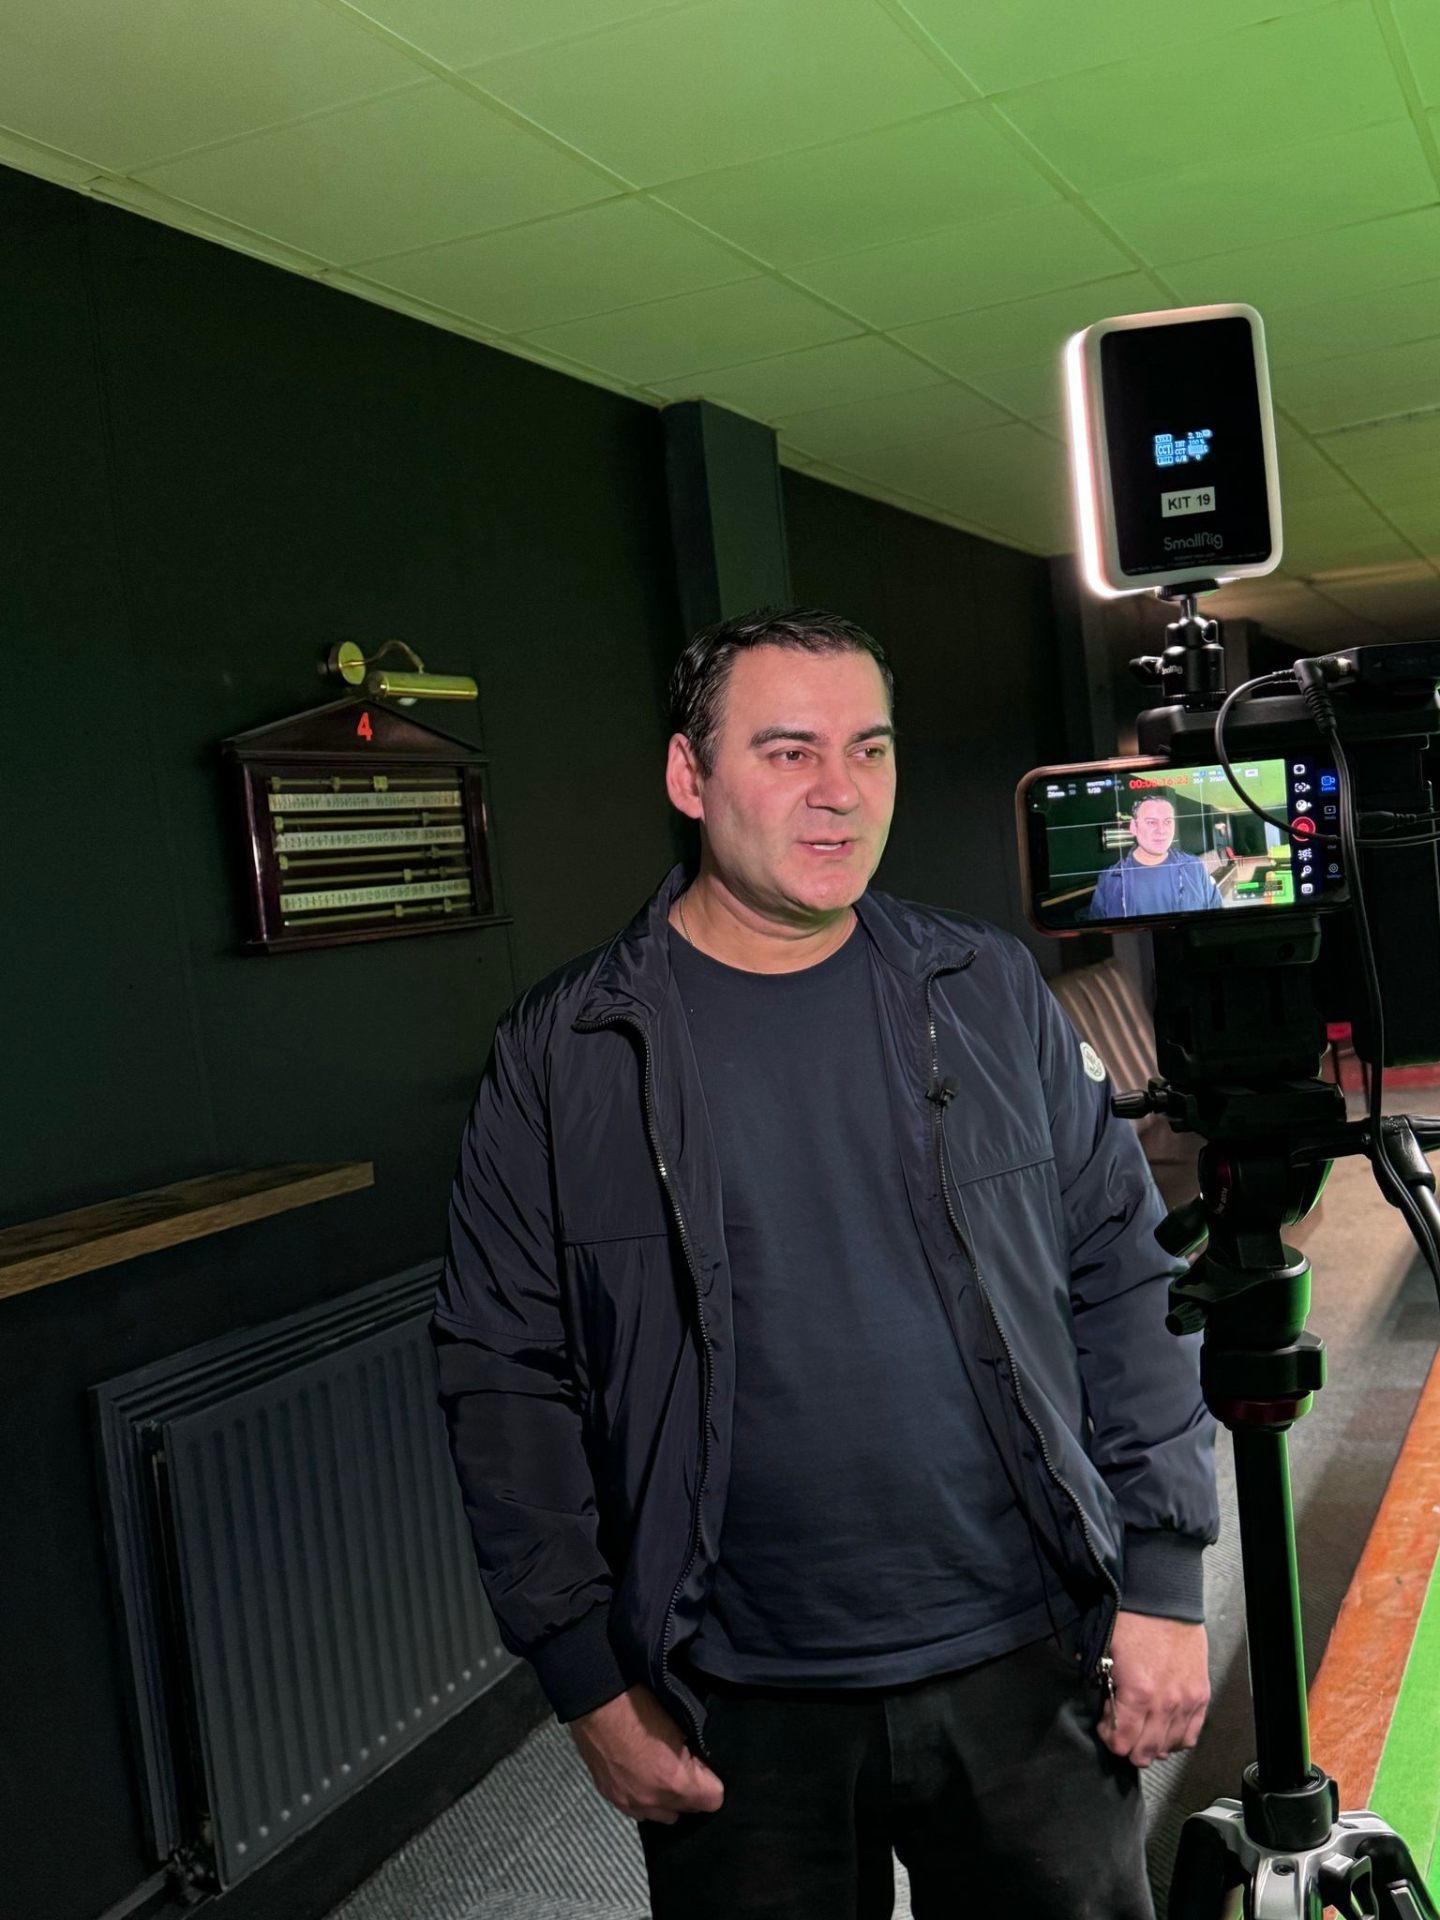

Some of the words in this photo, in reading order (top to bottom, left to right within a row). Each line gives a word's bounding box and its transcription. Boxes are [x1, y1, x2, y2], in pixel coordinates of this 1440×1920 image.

[1168, 495, 1191, 510] KIT
[1196, 493, 1211, 507] 19
[1163, 531, 1223, 551] SmallRig
[357, 711, 373, 741] 4
